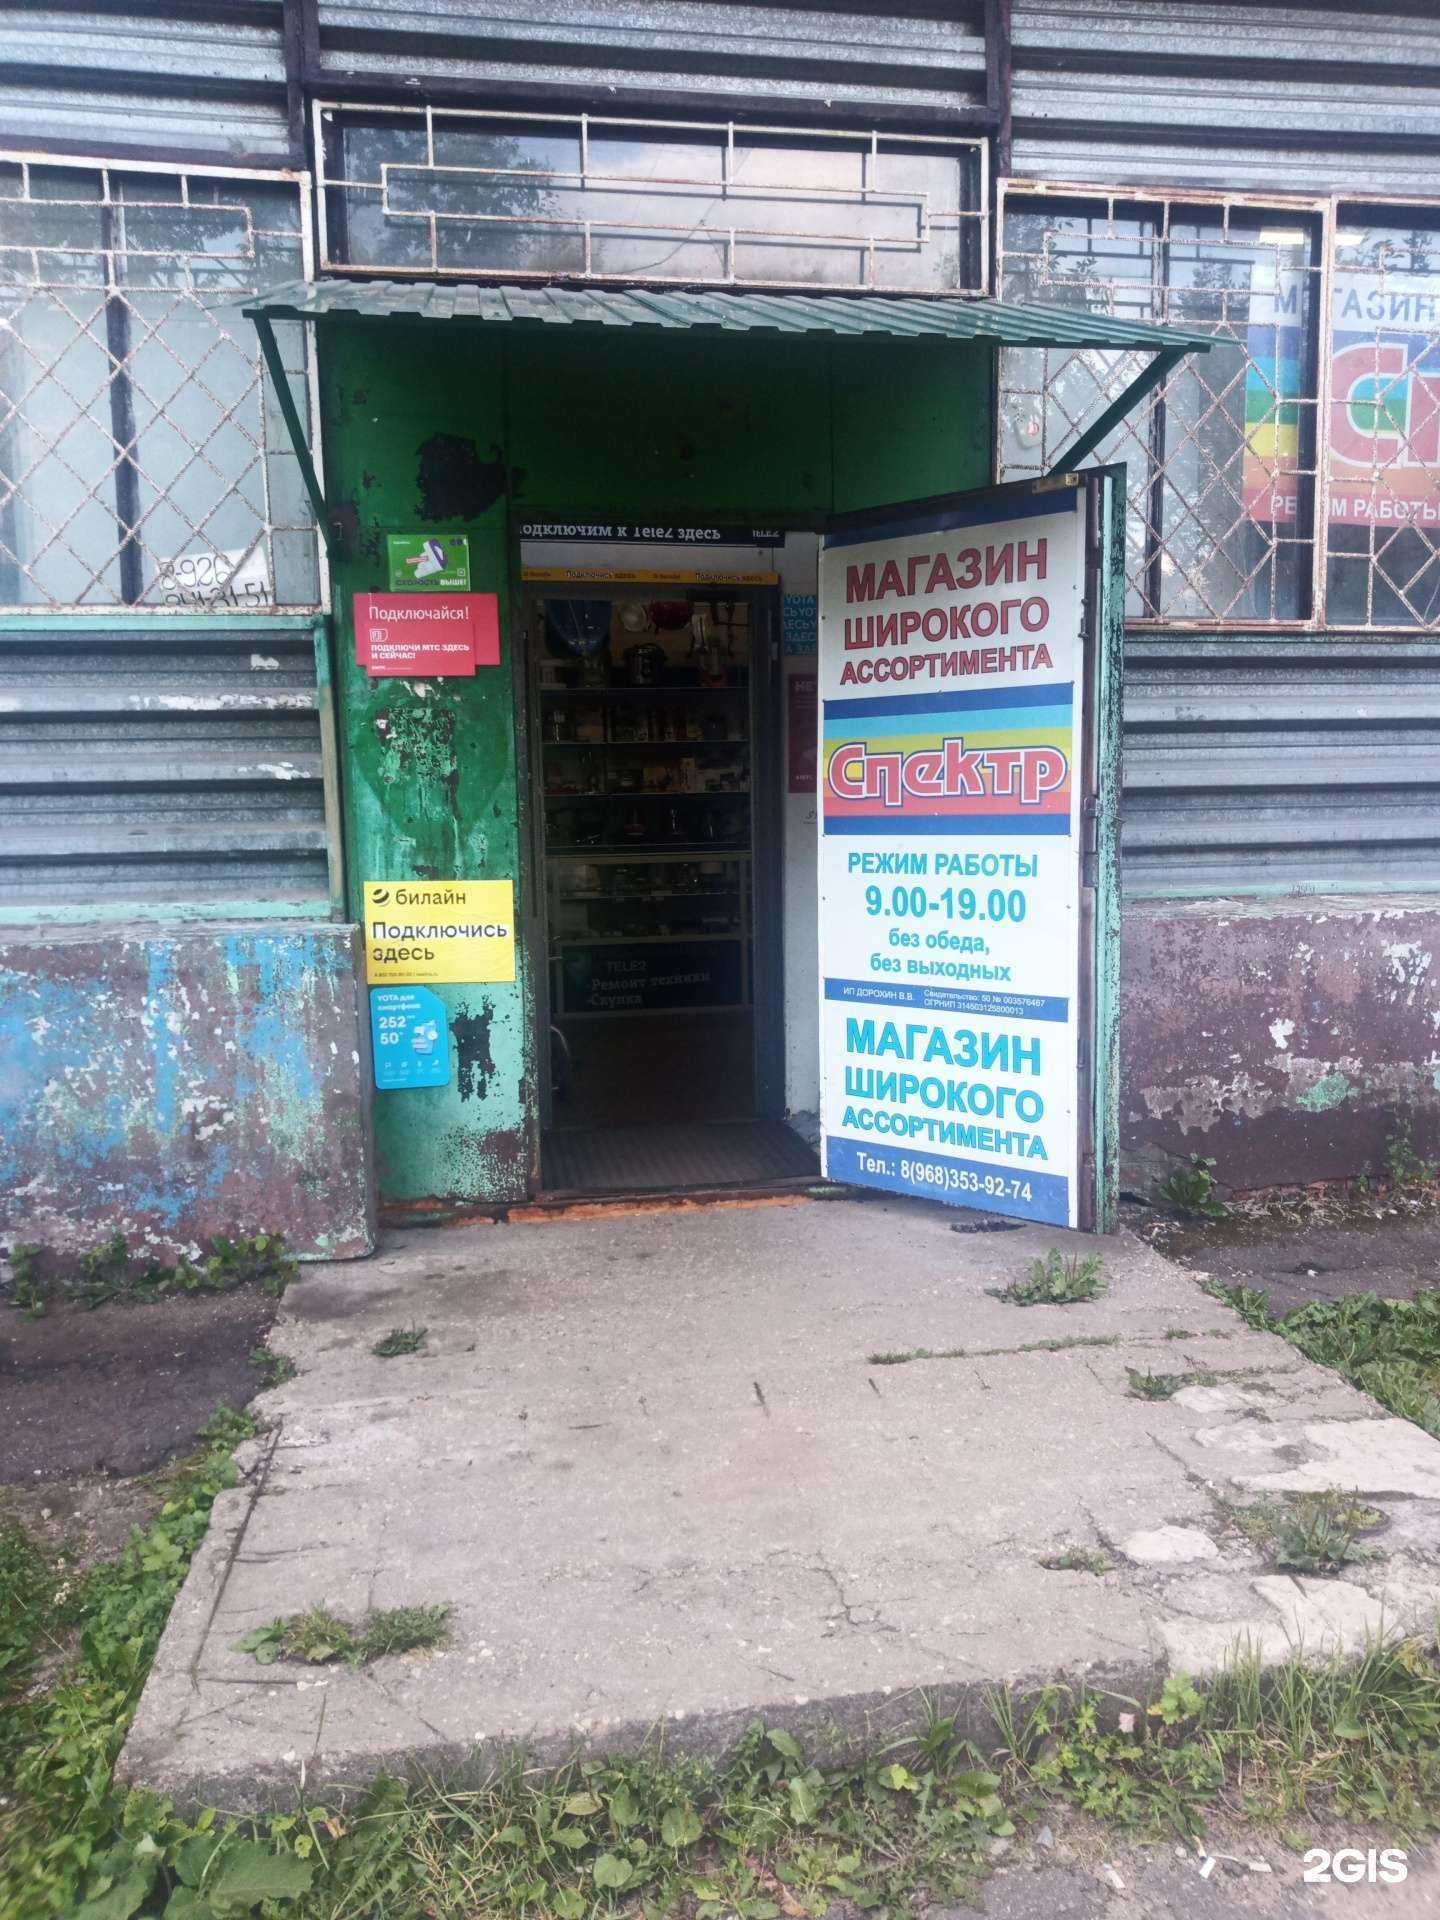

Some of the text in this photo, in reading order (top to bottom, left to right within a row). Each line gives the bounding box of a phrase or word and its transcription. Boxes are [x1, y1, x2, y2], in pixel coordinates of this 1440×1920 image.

[1274, 285, 1435, 322] МАЗИН
[1271, 495, 1346, 517] РЕМ
[519, 523, 612, 538] одключим
[617, 526, 627, 537] к
[678, 527, 721, 541] здесь
[846, 538, 1047, 603] МАГАЗИН
[368, 606, 469, 622] Подключайся!
[844, 597, 1050, 650] ШИРОКОГО
[371, 644, 470, 653] ПОДКЛЮЧИ МТС ЗДЕСЬ
[379, 651, 416, 659] СЕЙЧАС!
[840, 643, 1053, 685] АССОРТИМЕНТА
[828, 737, 1068, 807] Спектр
[848, 852, 1038, 878] РЕЖИМ РАБОТЫ
[396, 888, 466, 905] билайн
[865, 885, 1026, 923] 9.00-19.00
[372, 921, 507, 941] Подключись
[888, 928, 990, 955] без обеда,
[373, 947, 435, 963] здесь
[870, 953, 1012, 982] без выходных
[377, 994, 399, 1002] YOTA
[843, 987, 855, 996] ИП
[857, 987, 897, 999] ДОРОХИН
[378, 1015, 406, 1028] 252
[380, 1032, 400, 1045] 50
[846, 1018, 1040, 1076] МАГАЗИН
[845, 1066, 1044, 1123] ШИРОКОГО
[842, 1106, 1048, 1160] АССОРТИМЕНТА
[857, 1152, 1032, 1202] Тел.: 8(968)353-92-74
